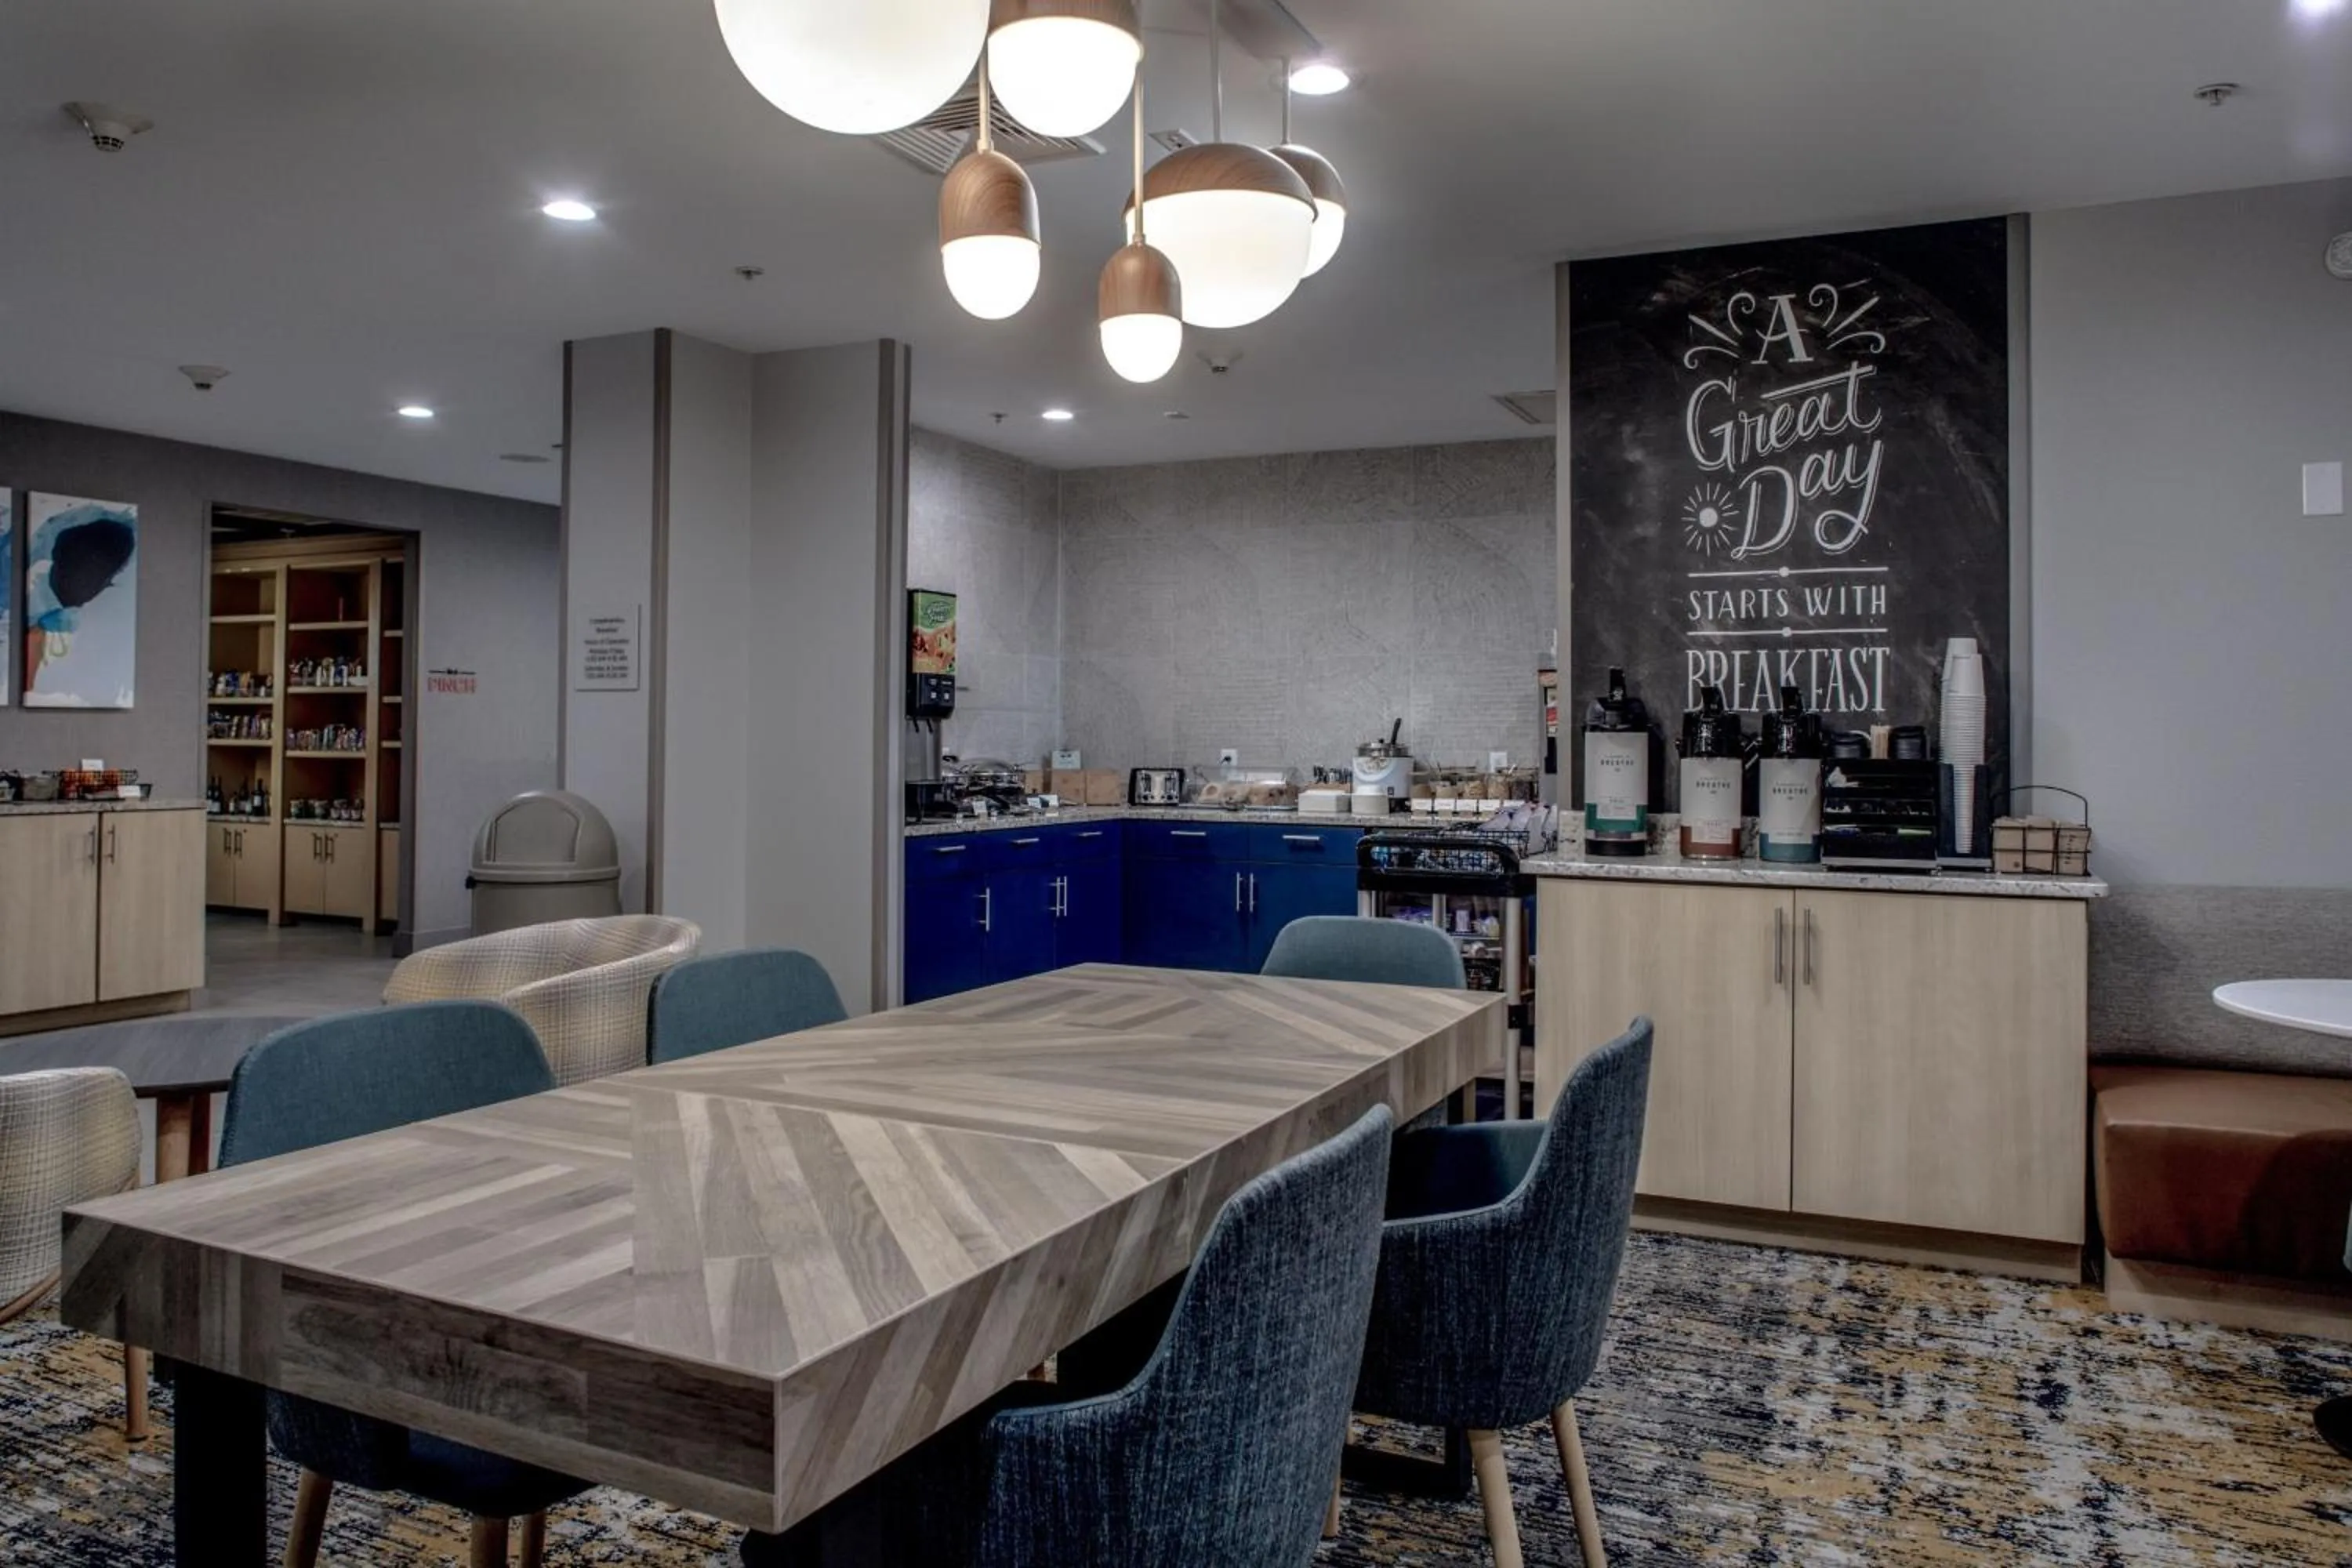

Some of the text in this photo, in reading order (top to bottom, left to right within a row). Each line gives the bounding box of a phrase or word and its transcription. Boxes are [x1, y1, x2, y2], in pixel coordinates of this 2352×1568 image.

[1751, 293, 1813, 364] A
[1686, 361, 1882, 472] Great
[1730, 439, 1882, 561] Day
[1688, 584, 1887, 622] STARTS WITH
[1683, 646, 1890, 713] BREAKFAST
